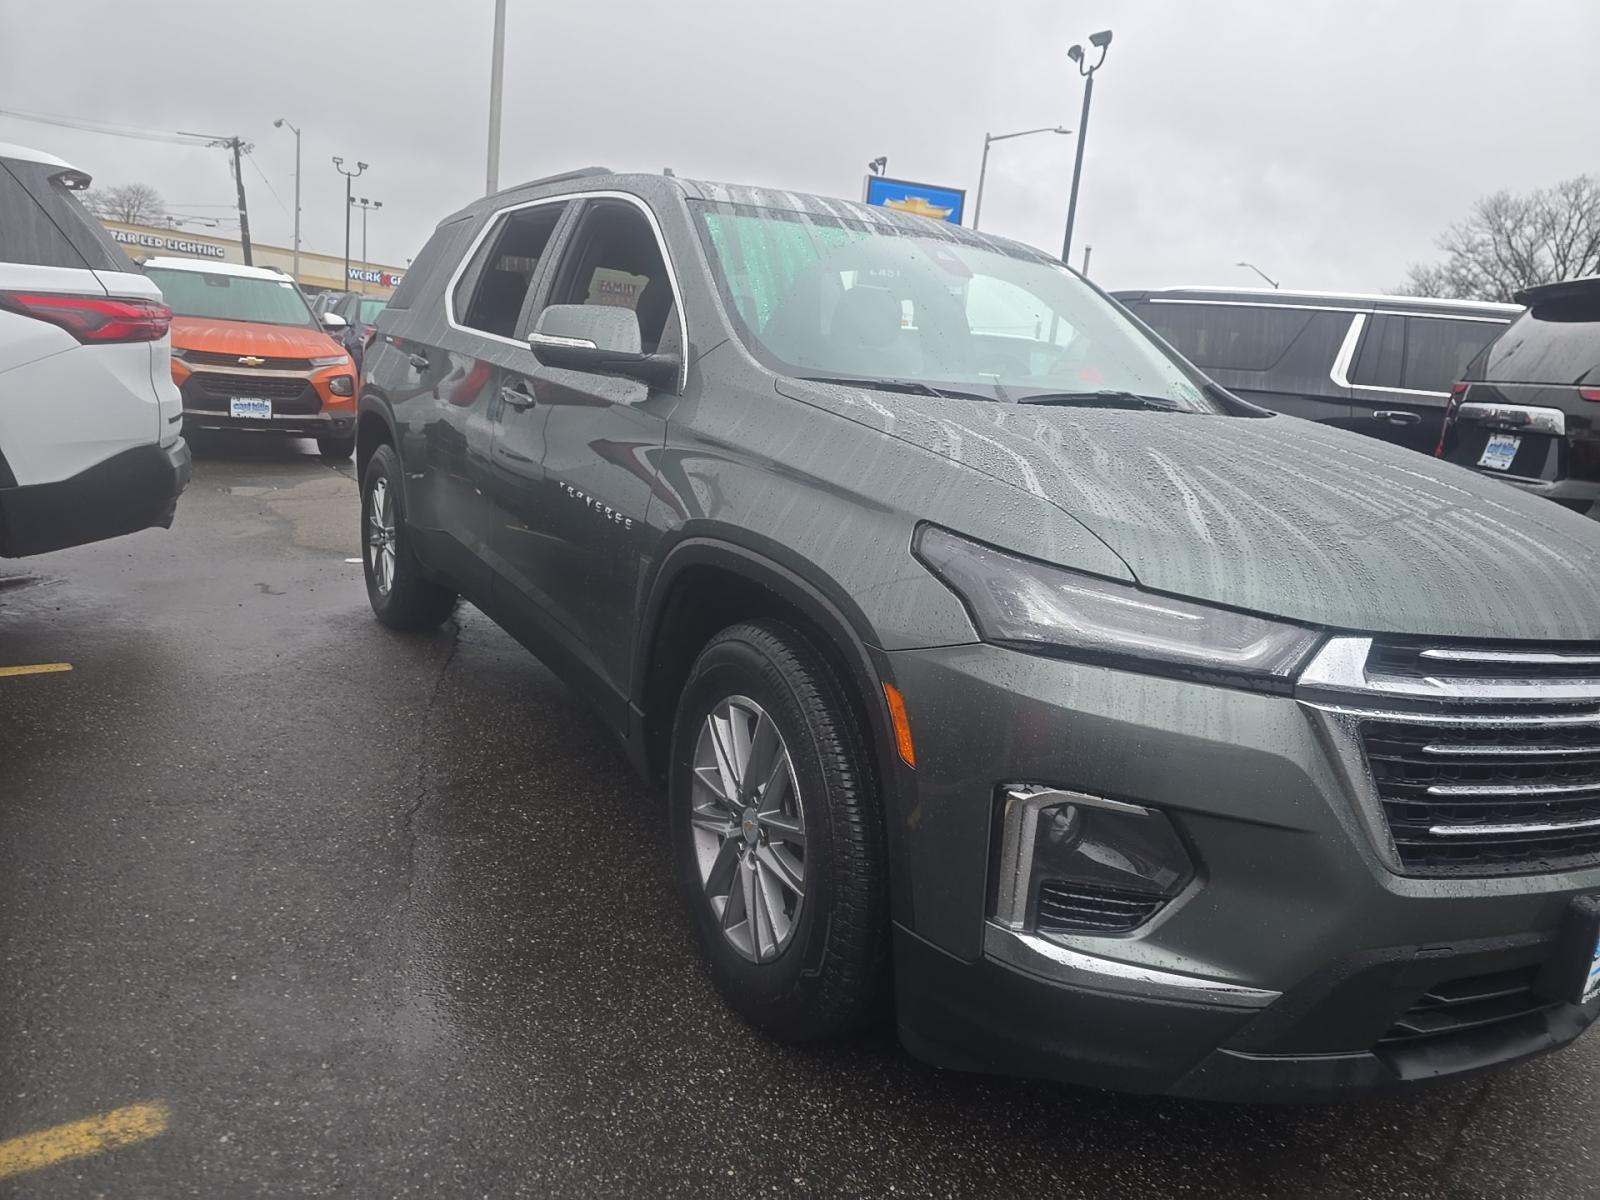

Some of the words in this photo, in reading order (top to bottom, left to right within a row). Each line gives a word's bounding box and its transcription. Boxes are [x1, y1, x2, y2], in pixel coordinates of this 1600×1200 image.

[109, 231, 137, 244] TAR
[139, 236, 162, 248] LED
[166, 239, 225, 257] LIGHTING
[348, 269, 381, 283] WORK
[560, 481, 633, 531] TRAVERSE
